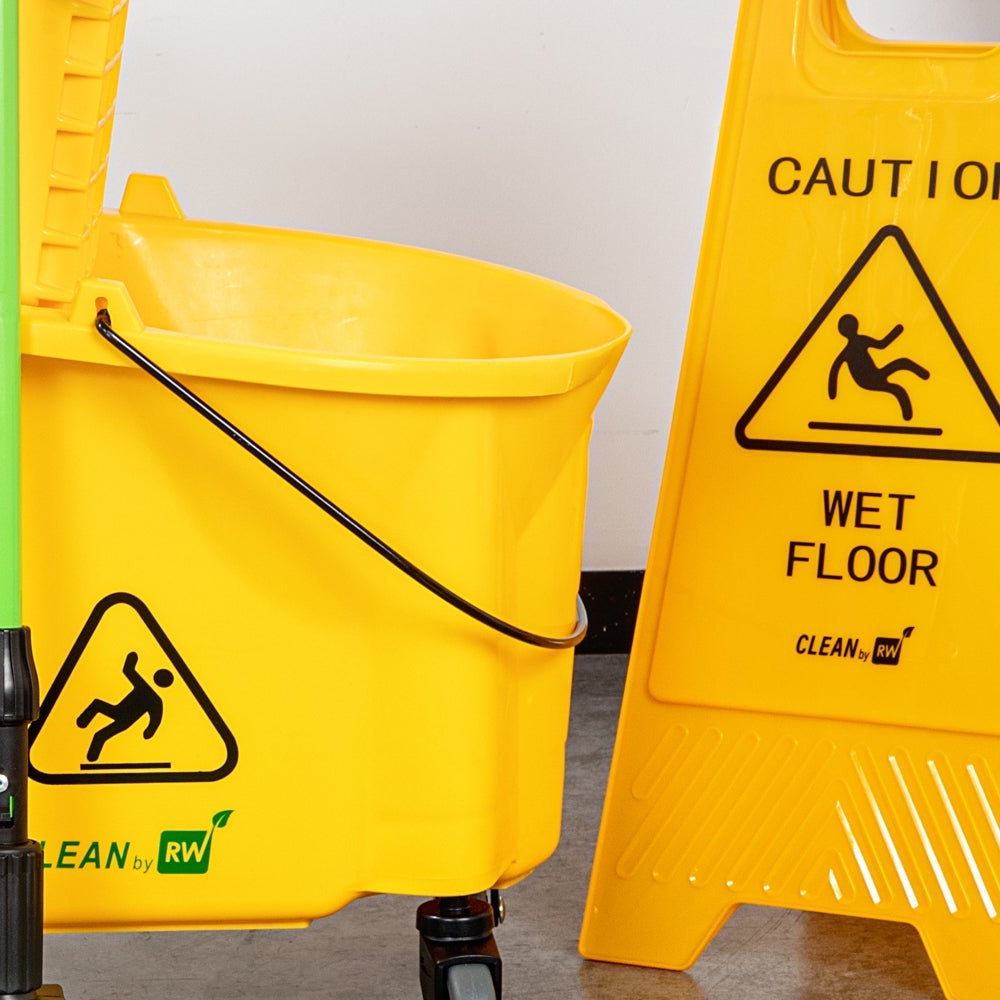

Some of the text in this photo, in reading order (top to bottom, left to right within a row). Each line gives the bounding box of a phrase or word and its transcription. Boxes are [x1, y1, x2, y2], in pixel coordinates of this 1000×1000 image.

[823, 489, 916, 531] WET
[786, 541, 939, 587] FLOOR
[795, 634, 900, 663] CLEAN by RW
[133, 856, 154, 874] by
[165, 841, 206, 863] RW
